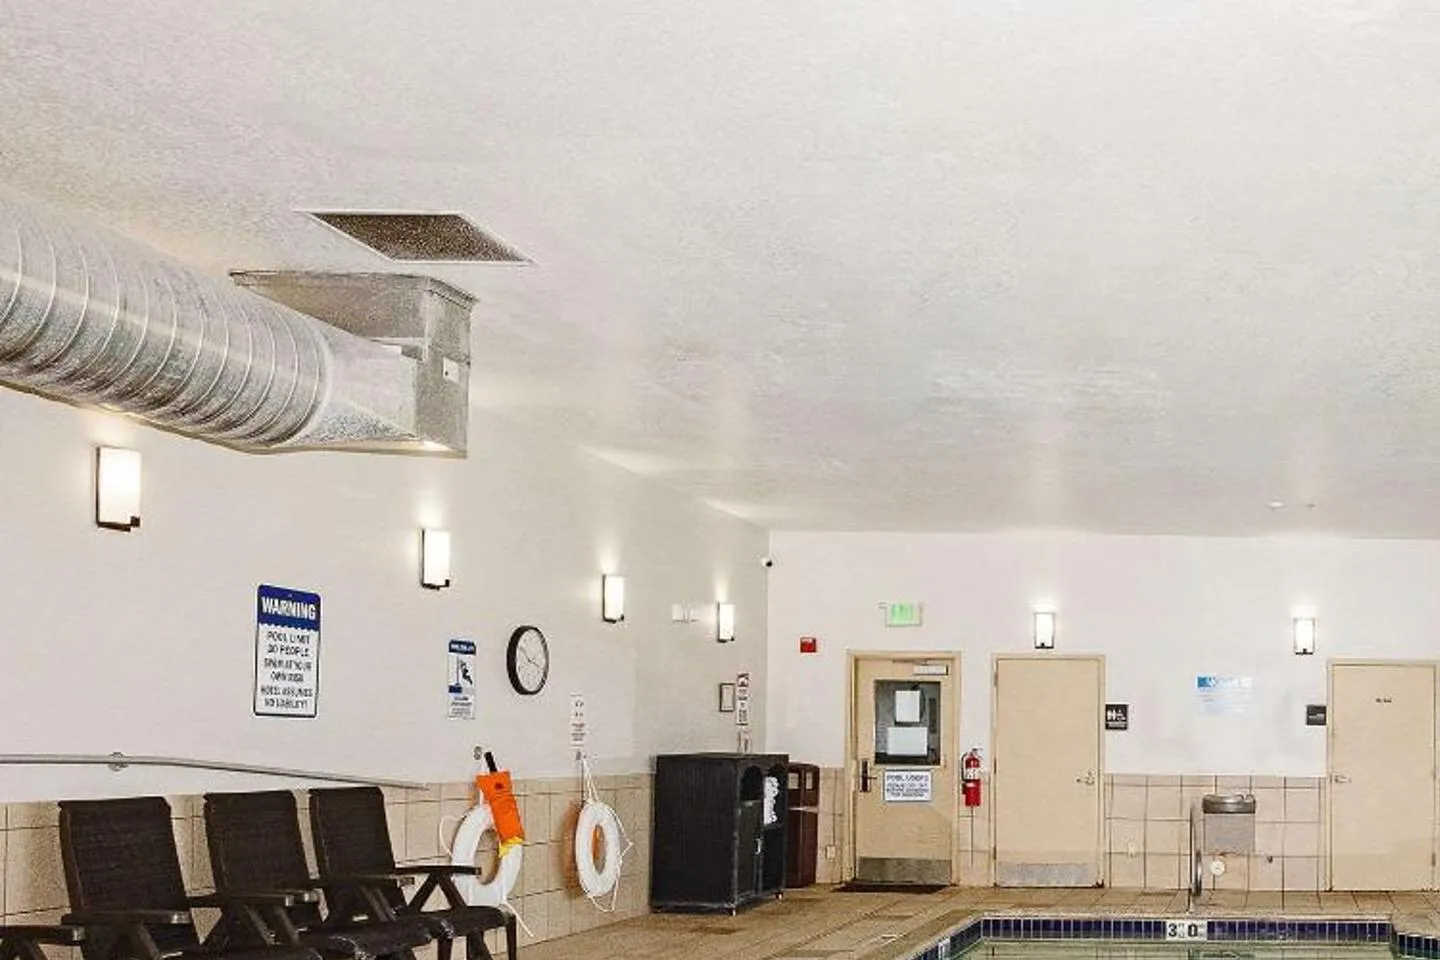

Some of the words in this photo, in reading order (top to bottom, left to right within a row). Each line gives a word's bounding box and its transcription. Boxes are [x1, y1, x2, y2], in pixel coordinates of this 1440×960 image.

[261, 596, 316, 620] WARNING
[280, 644, 309, 657] PEOPLE
[1168, 922, 1178, 938] 3
[1187, 923, 1199, 938] 0
